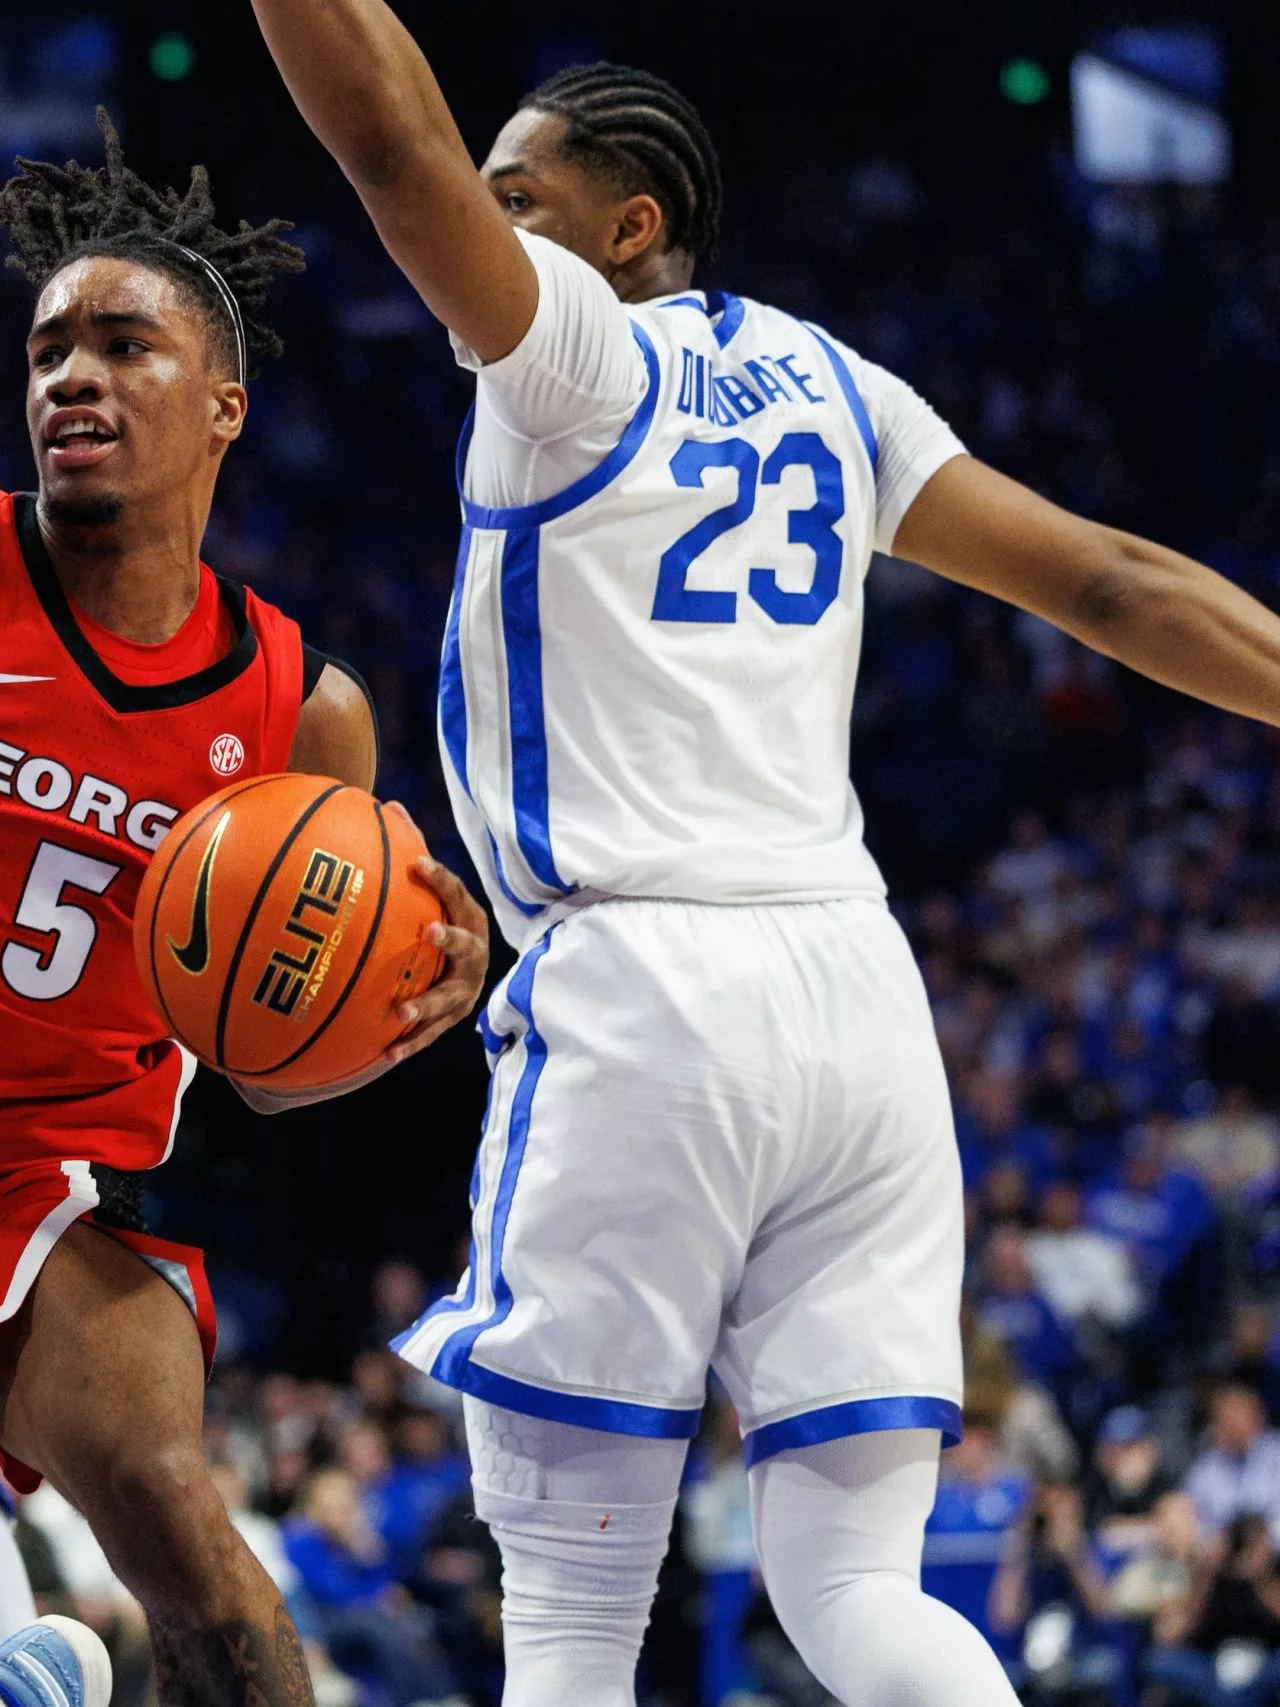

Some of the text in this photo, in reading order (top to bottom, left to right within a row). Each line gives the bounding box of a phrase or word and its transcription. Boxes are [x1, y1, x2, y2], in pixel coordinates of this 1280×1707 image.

[650, 432, 846, 626] 23
[210, 734, 243, 775] SEC
[250, 847, 356, 1018] ELITE
